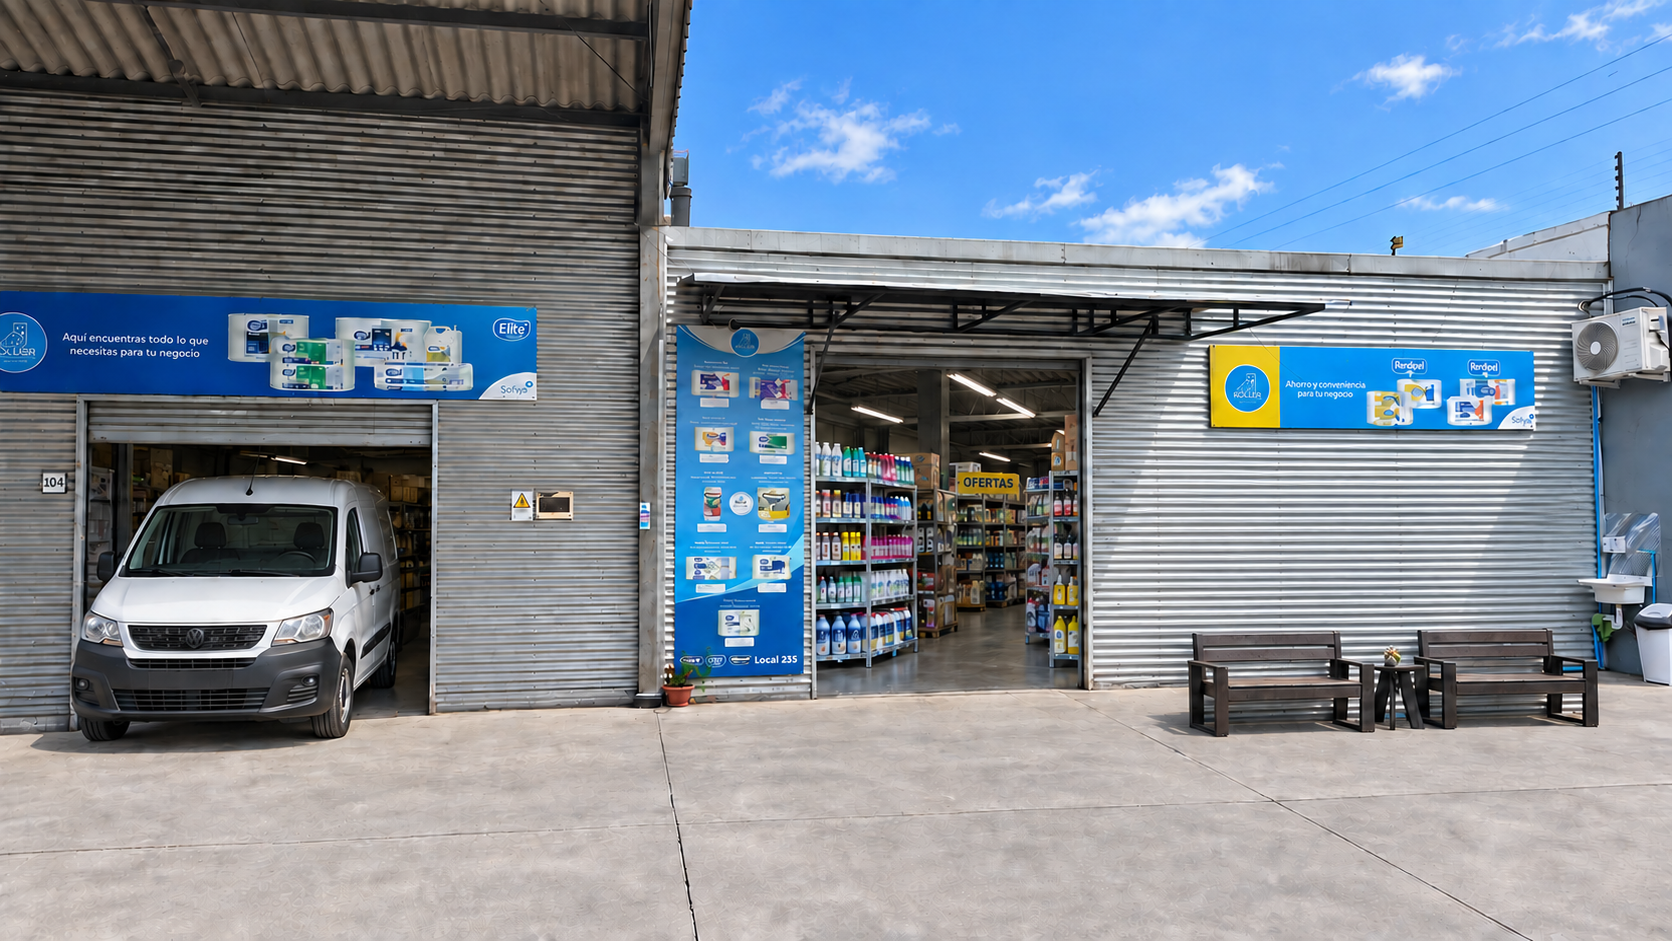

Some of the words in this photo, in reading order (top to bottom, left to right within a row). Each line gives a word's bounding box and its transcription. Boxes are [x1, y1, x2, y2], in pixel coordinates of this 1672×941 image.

[499, 322, 526, 335] Elite
[62, 332, 87, 344] Aquí
[89, 334, 146, 344] encuentras
[149, 335, 174, 345] todo
[176, 335, 187, 345] lo
[189, 337, 209, 347] que
[69, 346, 118, 356] necesitas
[120, 348, 144, 358] para
[146, 349, 157, 357] tu
[159, 348, 200, 360] negocio
[1285, 380, 1312, 388] Ahorro
[1312, 382, 1318, 390] y
[1319, 380, 1367, 389] conveniencia
[1297, 390, 1314, 399] para
[1315, 390, 1323, 398] tu
[1324, 391, 1354, 400] negocio
[43, 477, 65, 488] 104
[963, 477, 1014, 488] OFERTAS
[754, 655, 779, 664] Local
